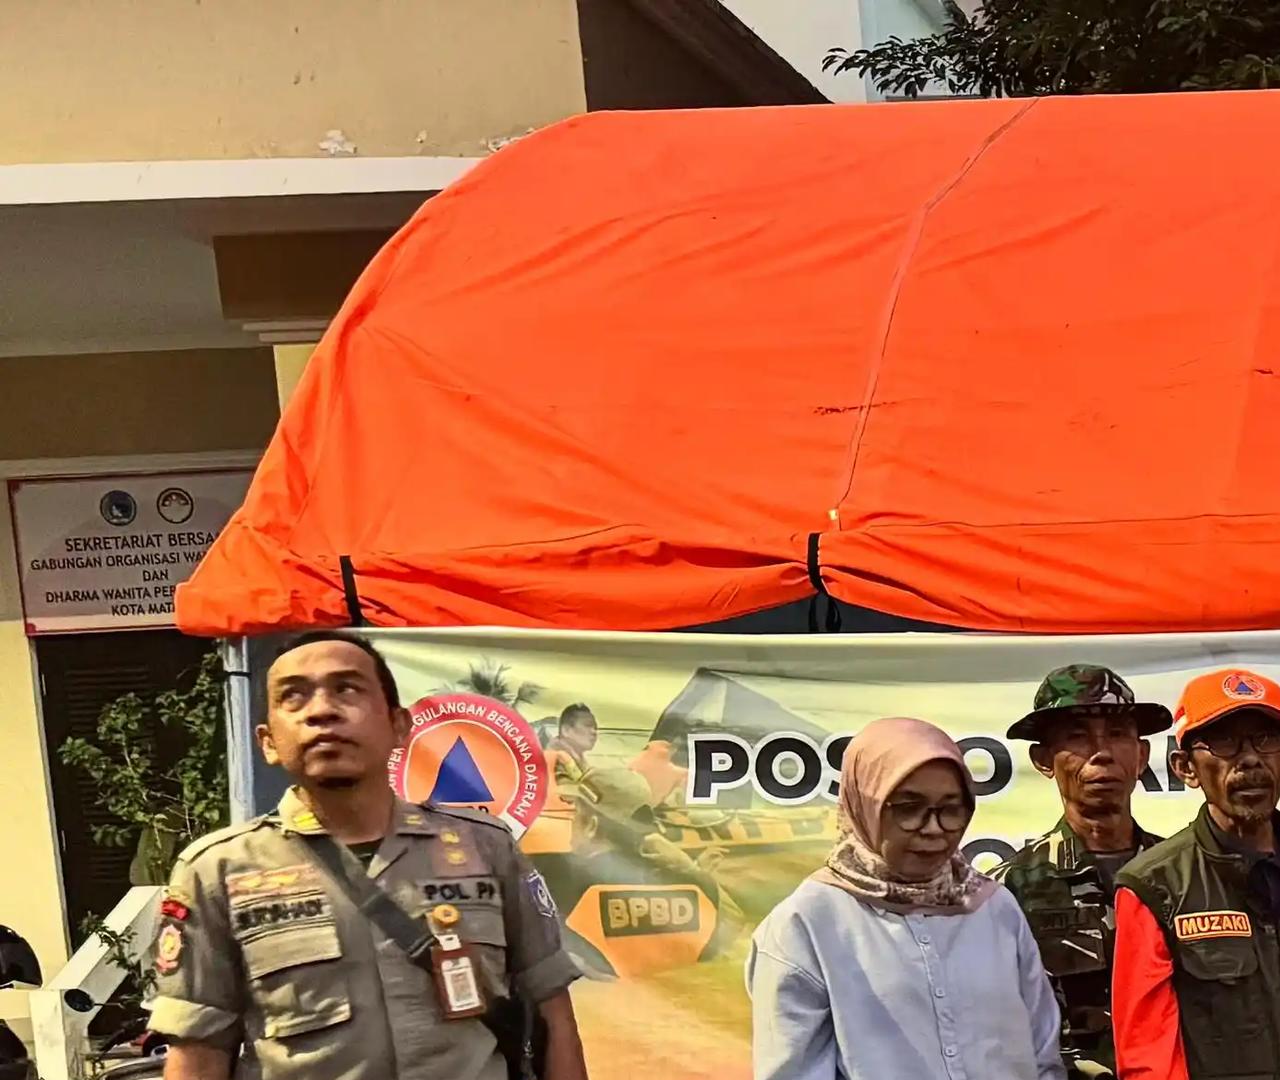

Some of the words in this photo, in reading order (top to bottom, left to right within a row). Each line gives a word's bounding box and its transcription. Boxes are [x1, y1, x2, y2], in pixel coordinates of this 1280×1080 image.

[65, 534, 163, 552] SEKRETARIAT
[168, 532, 219, 547] BERSA
[31, 556, 103, 571] GABUNGAN
[105, 552, 181, 567] ORGANISASI
[142, 569, 169, 582] DAN
[45, 590, 100, 604] DHARMA
[102, 586, 151, 601] WANITA
[111, 603, 146, 616] KOTA
[486, 709, 533, 763] BENCANA
[513, 763, 539, 818] DAERAH
[424, 884, 473, 901] POL
[606, 895, 697, 928] BPBD
[1182, 914, 1248, 937] MUZAKI
